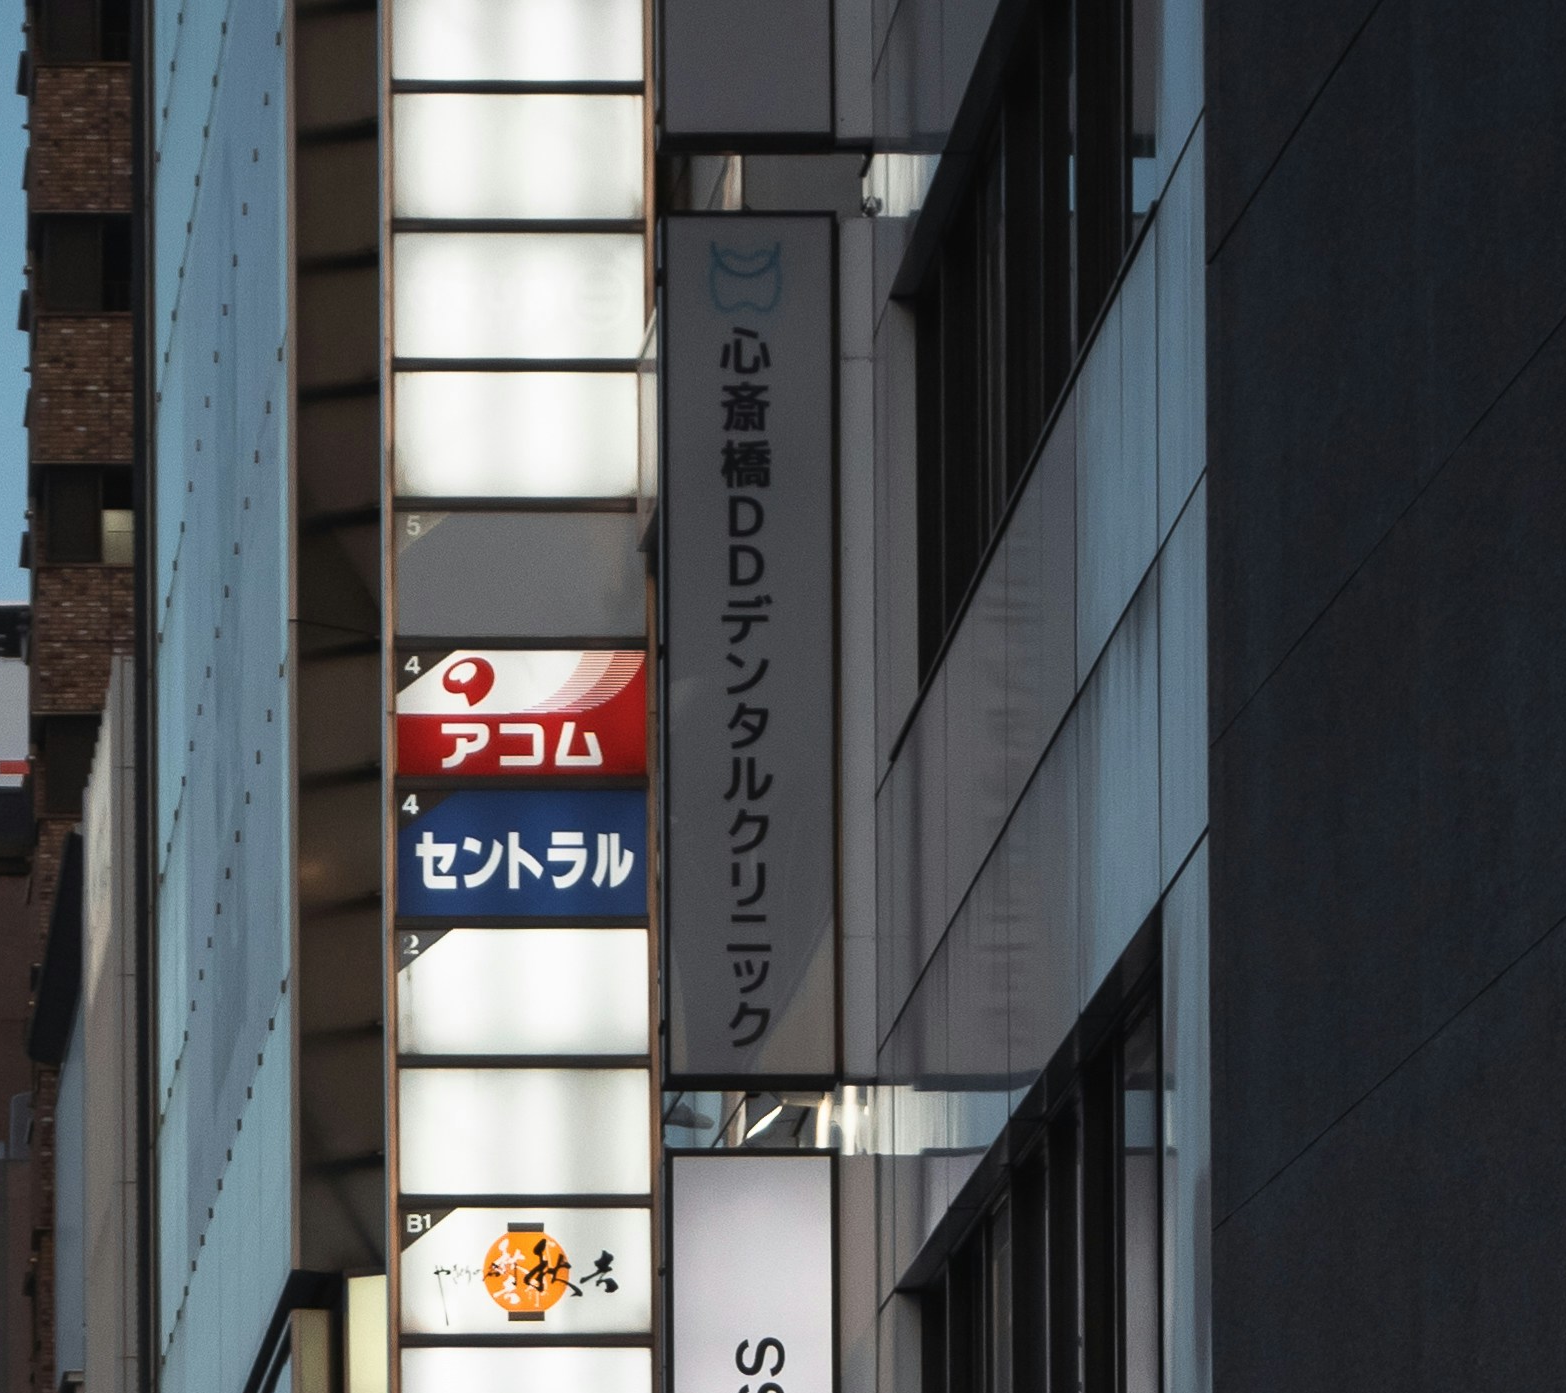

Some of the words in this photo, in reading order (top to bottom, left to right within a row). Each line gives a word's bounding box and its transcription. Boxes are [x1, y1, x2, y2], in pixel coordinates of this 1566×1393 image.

[404, 514, 421, 538] 5
[403, 654, 422, 676] 4
[440, 720, 606, 770] アコム
[401, 793, 420, 815] 4
[415, 829, 636, 892] セントラル
[401, 933, 420, 955] 2
[406, 1213, 432, 1234] B1
